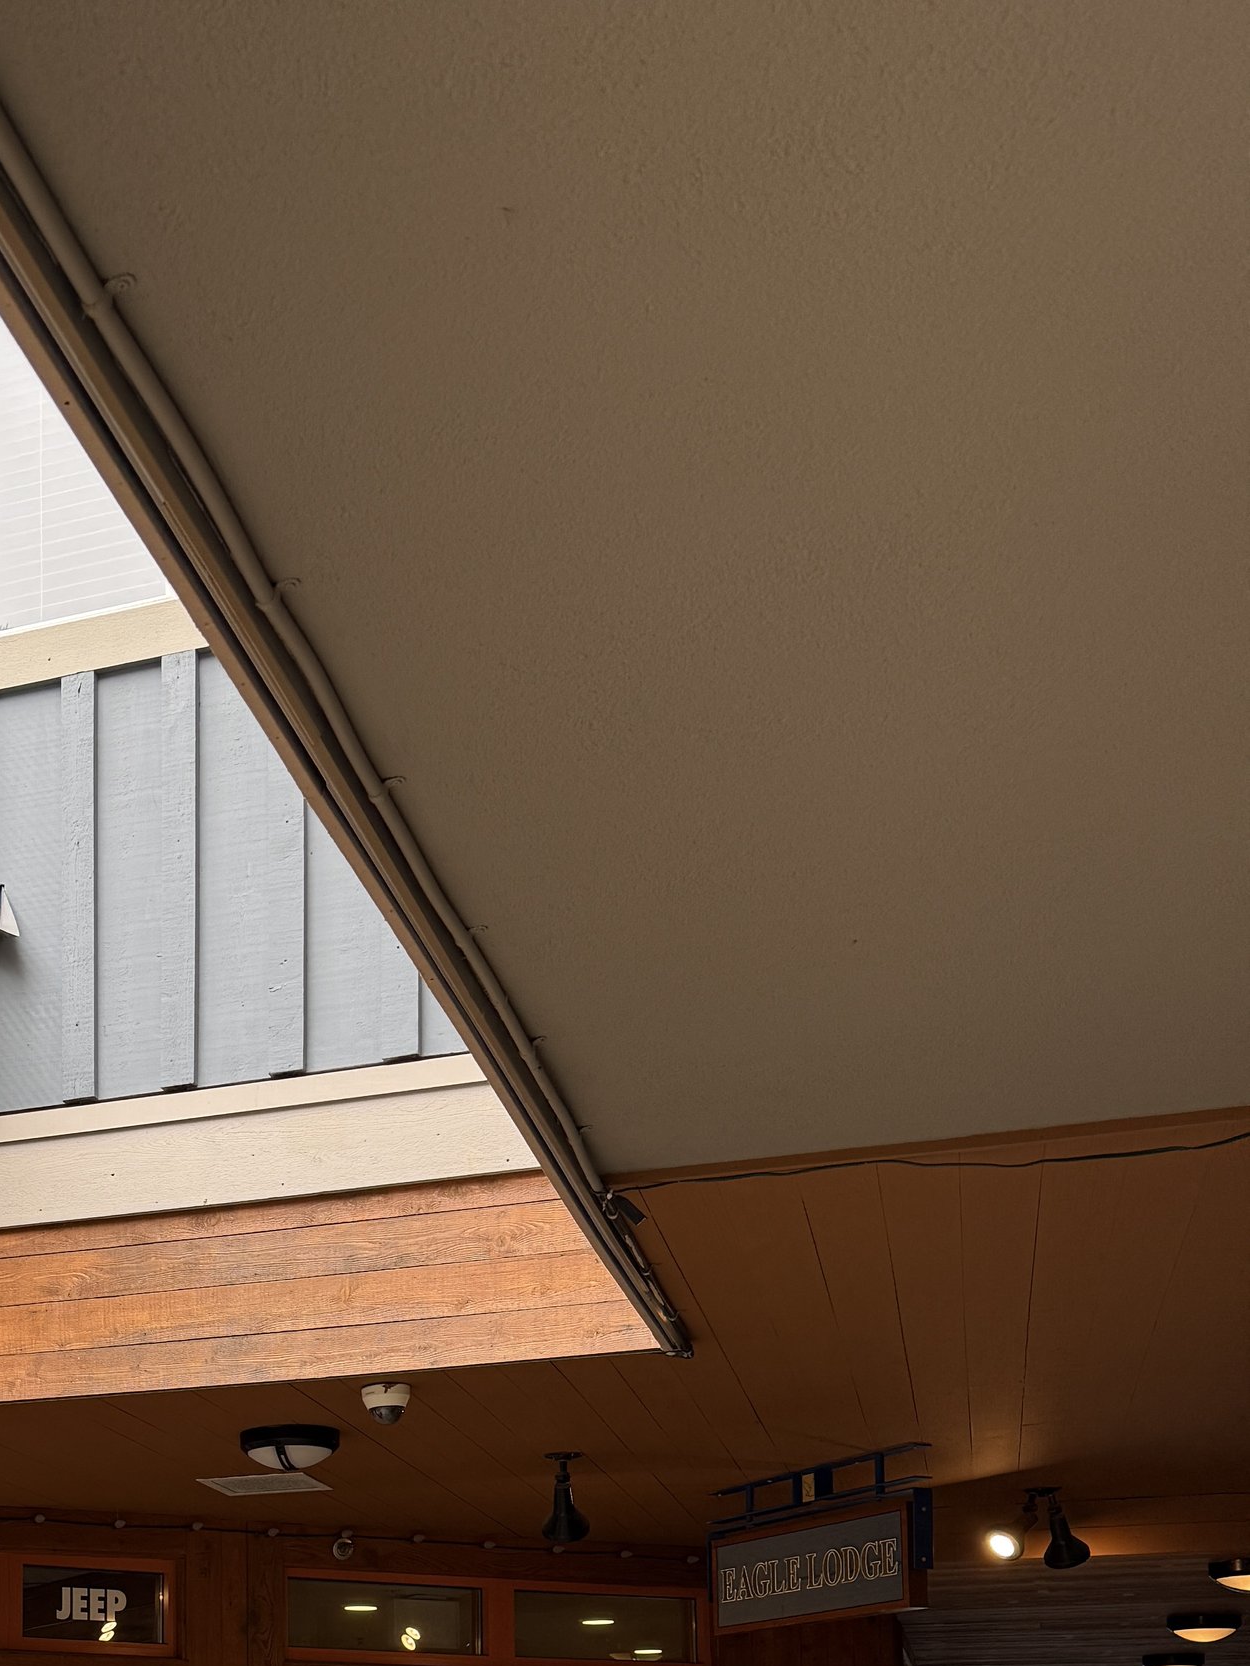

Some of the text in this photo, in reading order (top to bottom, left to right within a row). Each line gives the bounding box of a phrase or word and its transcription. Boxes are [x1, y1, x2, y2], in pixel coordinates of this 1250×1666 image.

[721, 1538, 899, 1603] EAGLE LODGE
[56, 1587, 127, 1622] JEEP
